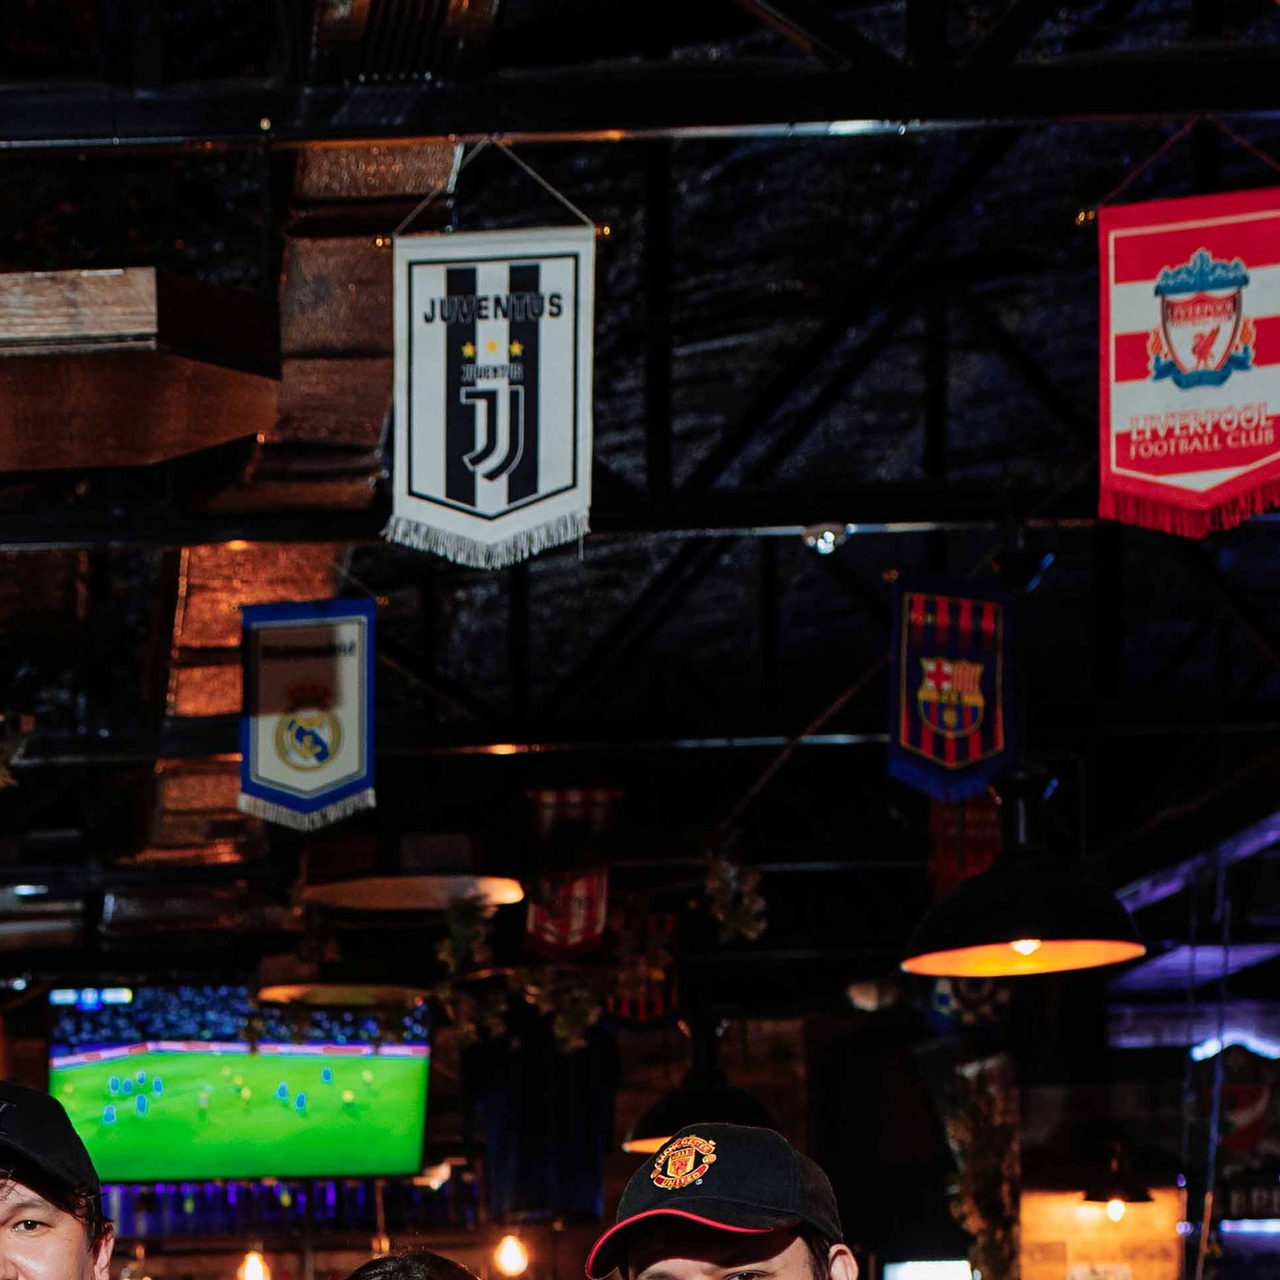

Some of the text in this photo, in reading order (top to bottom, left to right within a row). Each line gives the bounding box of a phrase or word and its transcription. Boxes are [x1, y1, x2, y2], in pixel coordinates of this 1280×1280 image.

[423, 292, 563, 325] JUVENTUS
[1129, 402, 1274, 440] LIVERPOOL
[1129, 426, 1276, 460] FOOTBALL CLUB
